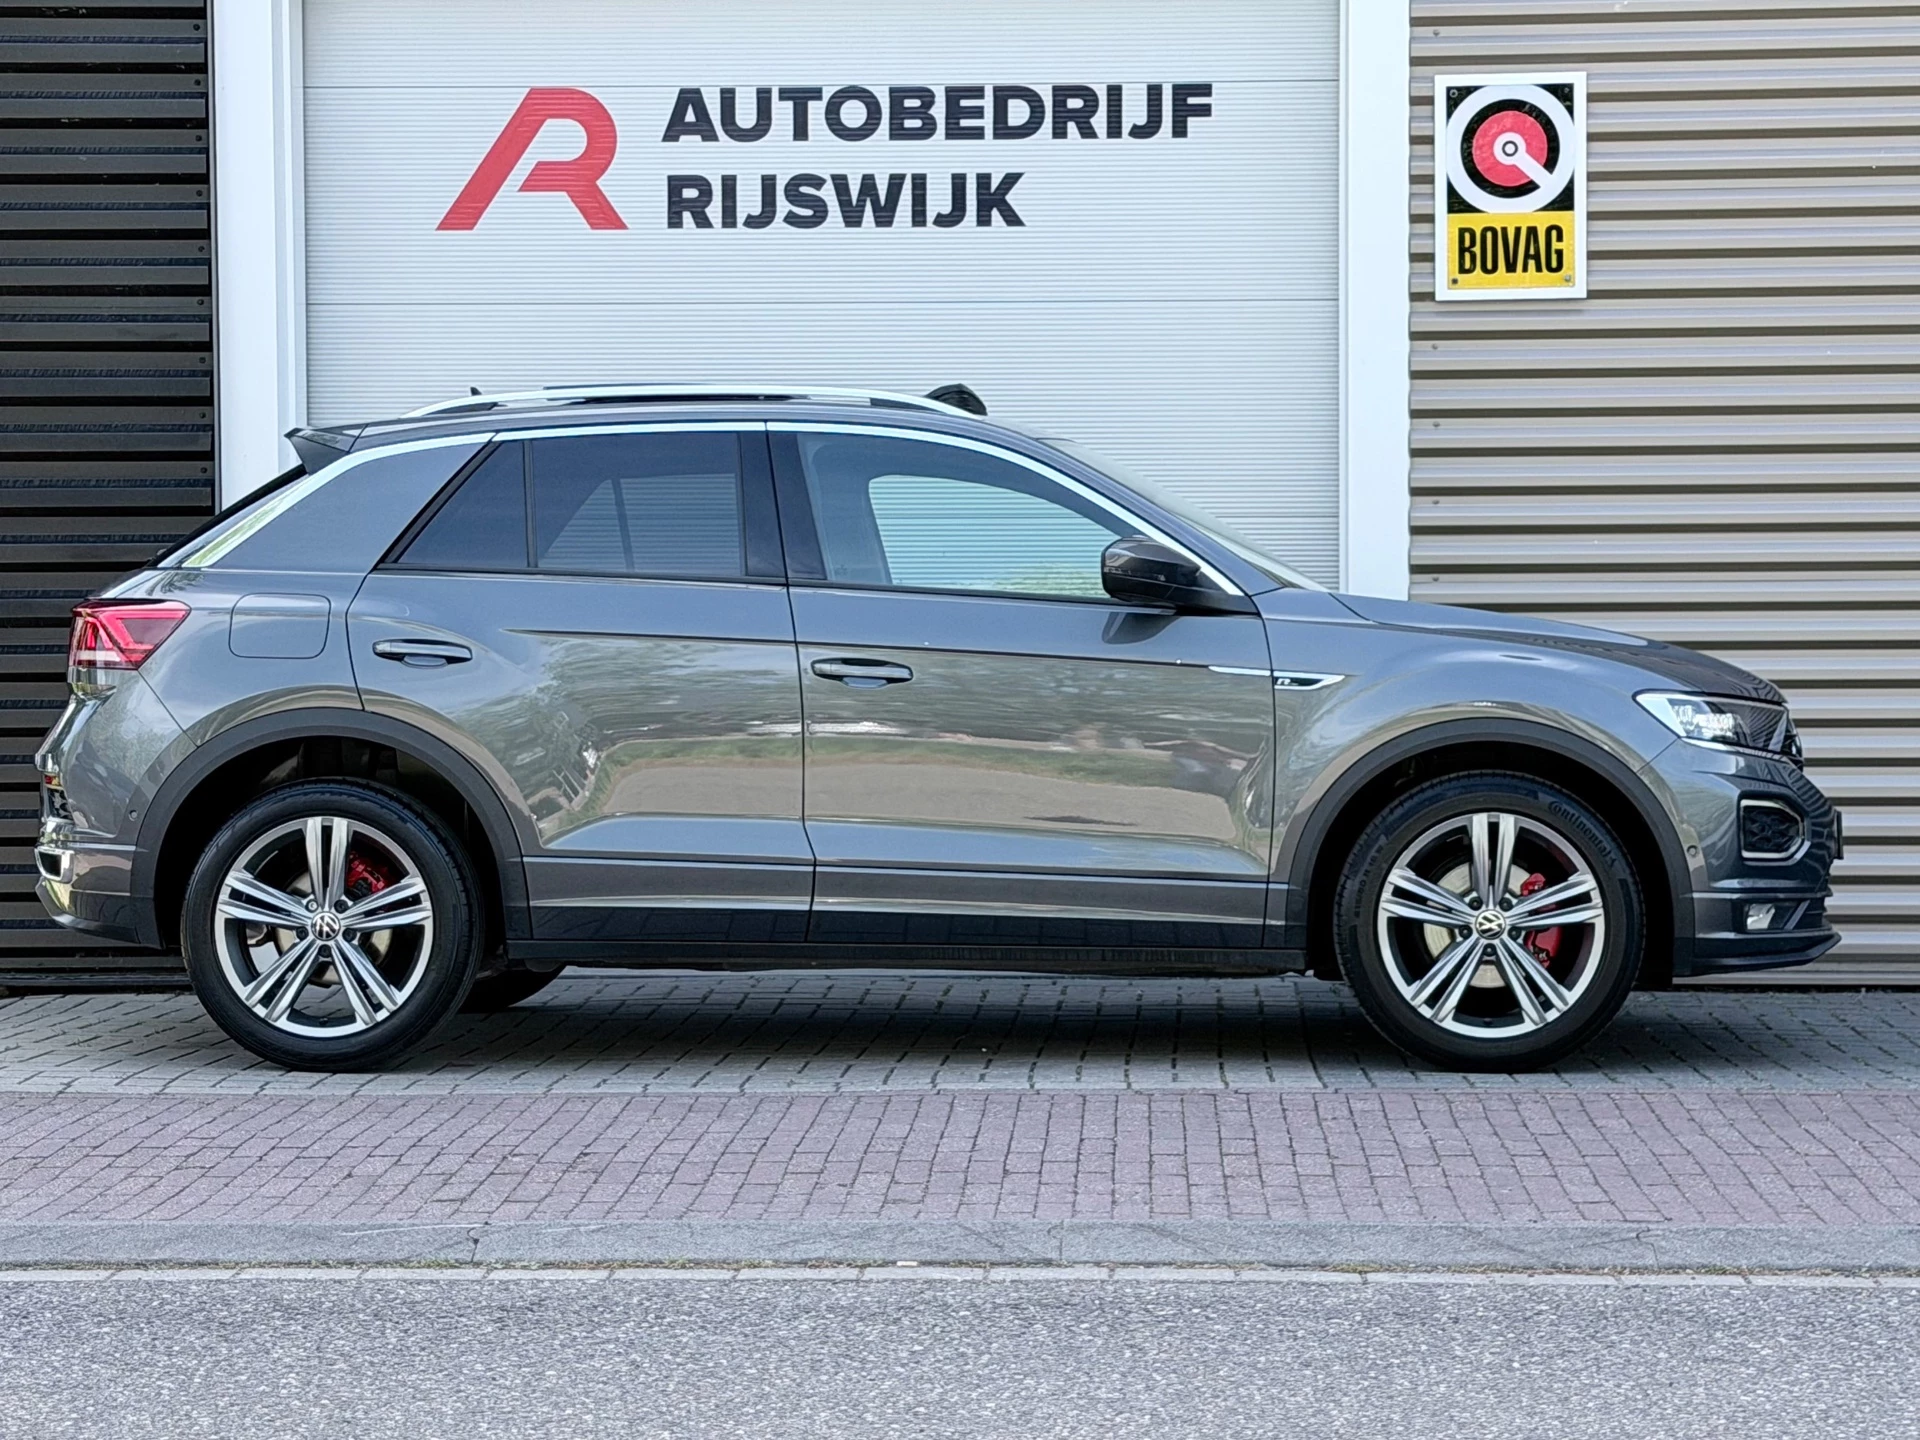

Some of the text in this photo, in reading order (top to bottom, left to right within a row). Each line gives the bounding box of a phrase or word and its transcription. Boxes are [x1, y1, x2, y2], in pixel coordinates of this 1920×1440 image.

[661, 83, 1213, 142] AUTOBEDRIJF
[667, 172, 1027, 229] RIJSWIJK
[1457, 224, 1564, 275] BOVAG
